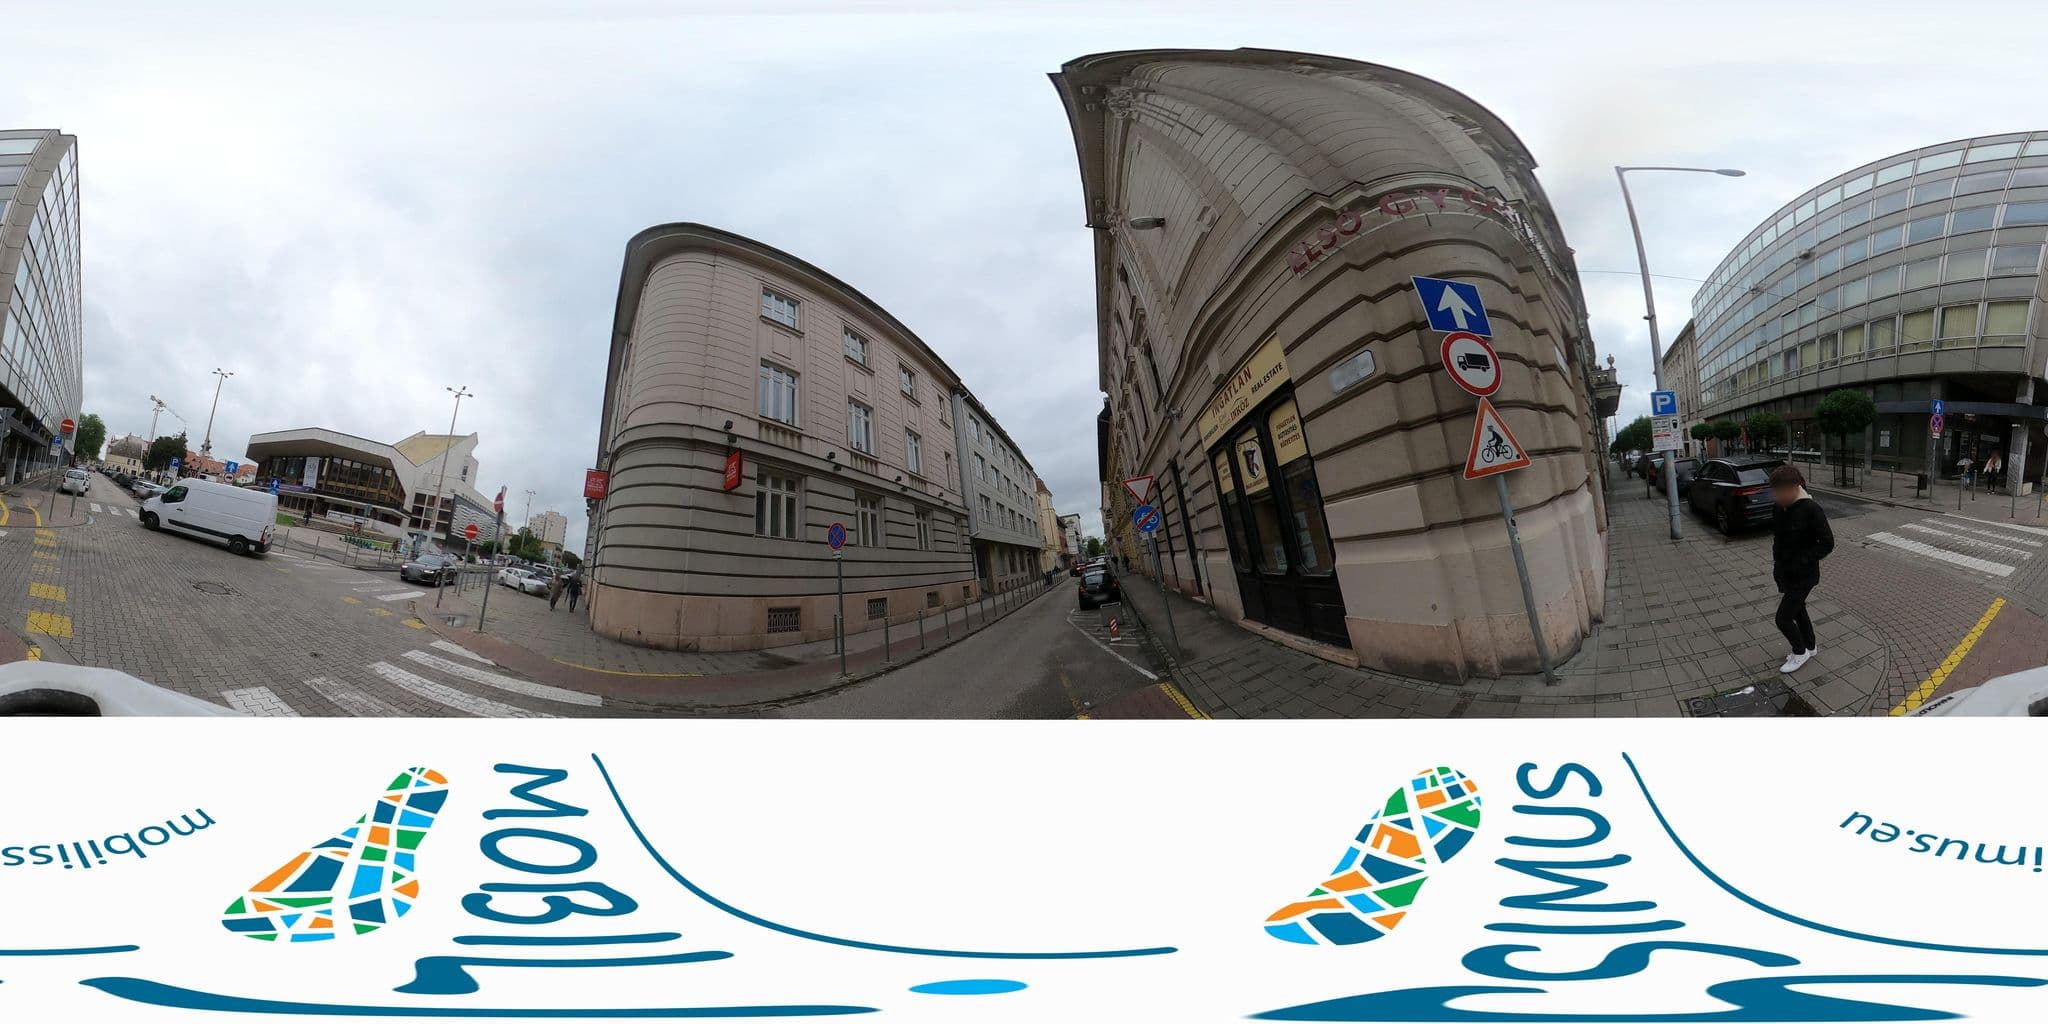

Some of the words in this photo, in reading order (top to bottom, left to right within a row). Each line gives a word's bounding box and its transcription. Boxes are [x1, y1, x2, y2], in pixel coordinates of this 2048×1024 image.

[1211, 366, 1253, 418] INGATLAN
[1251, 382, 1264, 394] REAL
[1262, 362, 1284, 384] ESTATE
